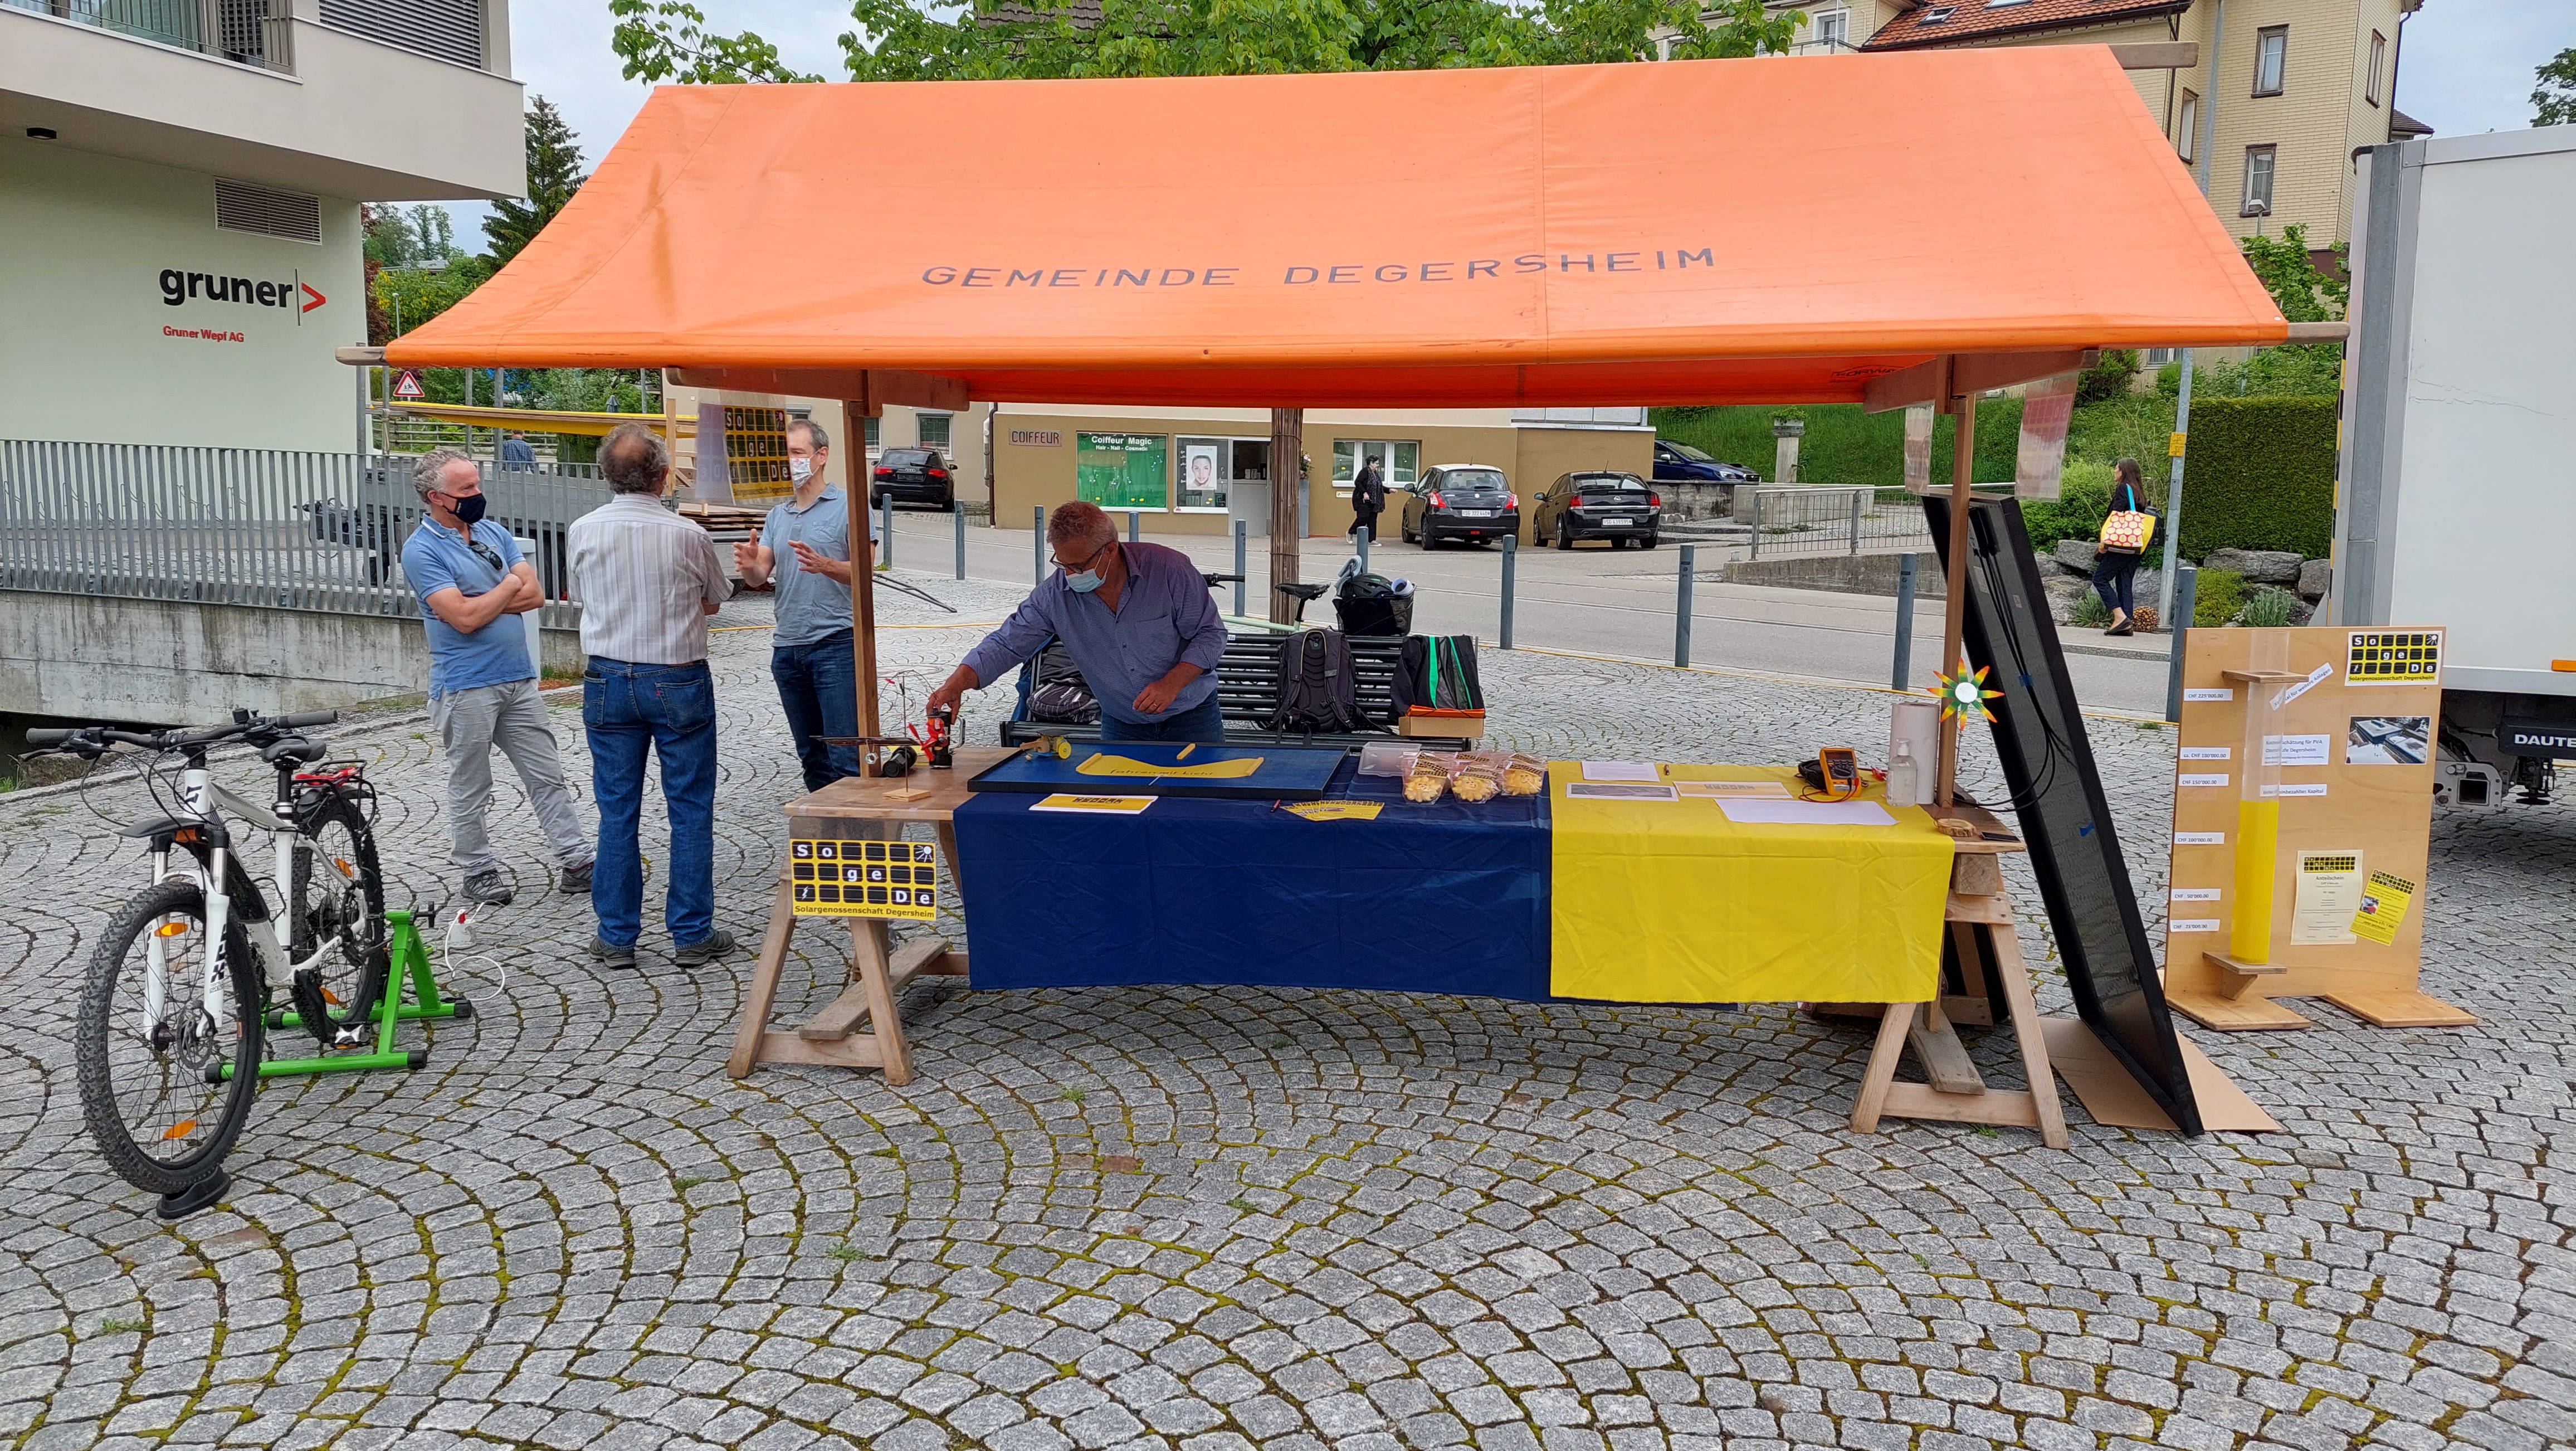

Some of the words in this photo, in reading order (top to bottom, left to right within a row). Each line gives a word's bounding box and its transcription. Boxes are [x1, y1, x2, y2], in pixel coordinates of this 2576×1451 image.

[921, 265, 1238, 288] GEMEINDE
[1284, 247, 1716, 285] DEGERSHEIM
[159, 269, 292, 308] gruner
[163, 325, 199, 338] Gruner
[201, 329, 227, 343] Wepf
[229, 332, 244, 342] AG
[1012, 431, 1060, 444] COIFFEUR
[1091, 436, 1124, 444] Coiffeur
[1128, 436, 1152, 445] Magic
[2314, 668, 2331, 681] Anlagen
[795, 905, 884, 916] Solargenossenschaft
[886, 908, 934, 918] Degersheim
